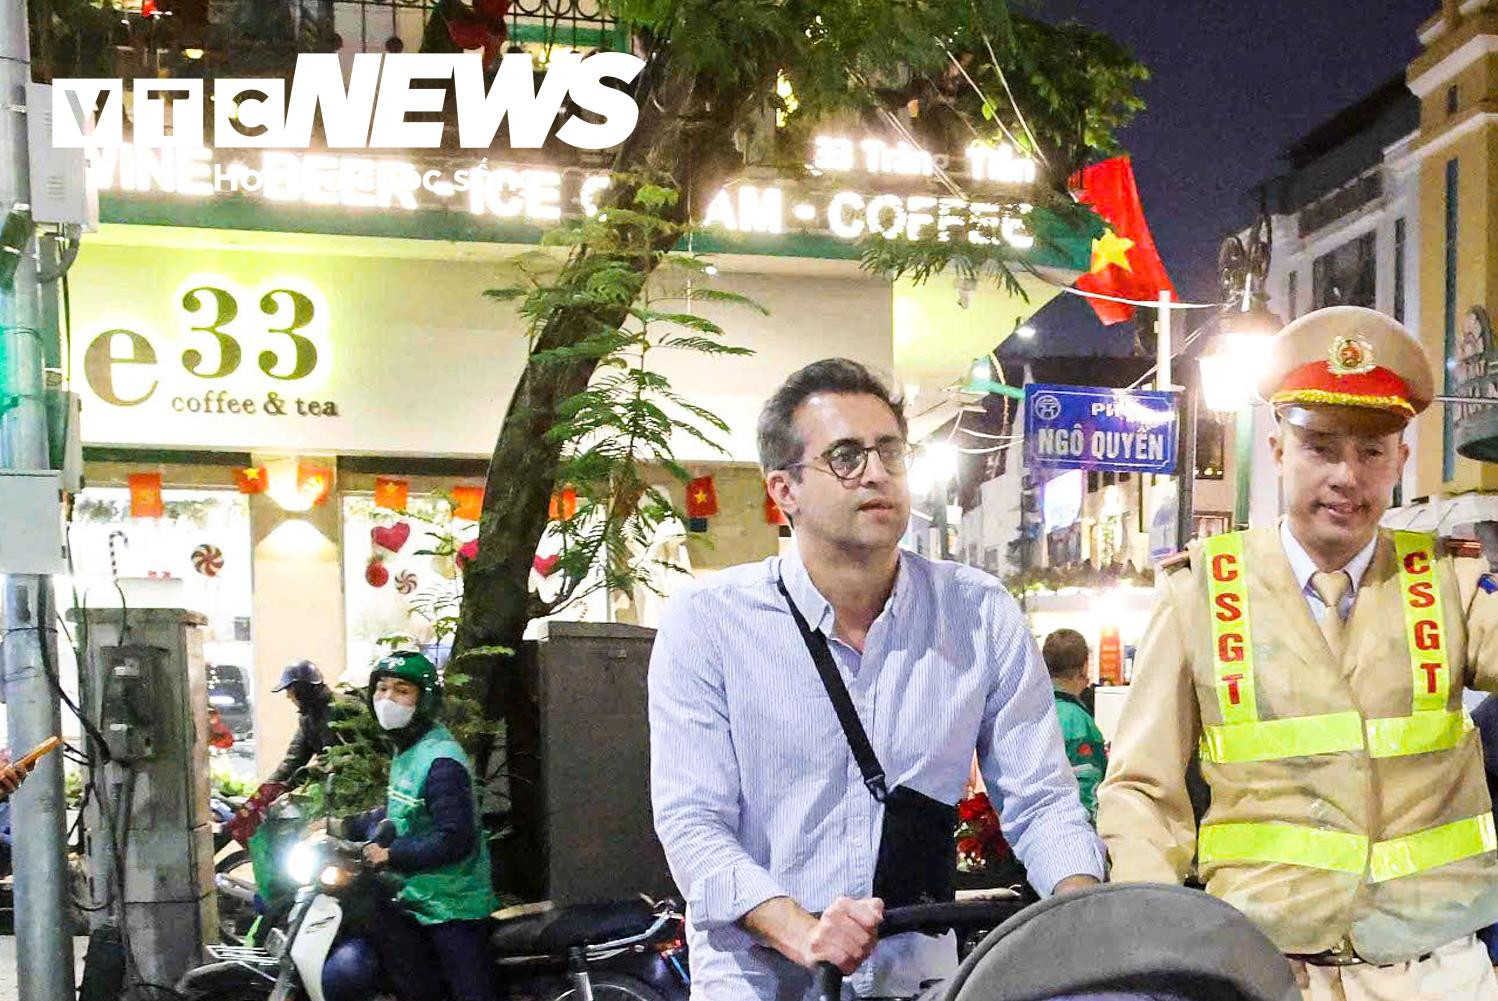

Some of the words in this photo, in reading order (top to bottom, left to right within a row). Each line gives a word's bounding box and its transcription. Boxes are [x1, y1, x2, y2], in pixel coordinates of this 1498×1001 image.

[262, 151, 418, 209] BEER
[469, 166, 562, 220] ICE
[171, 389, 257, 413] coffee
[263, 391, 287, 415] &
[296, 396, 339, 417] tea
[1037, 422, 1084, 458] NGÔ
[1091, 423, 1164, 461] QUYỀN
[1211, 553, 1245, 706] CSGT
[1402, 551, 1442, 694] CSGT
